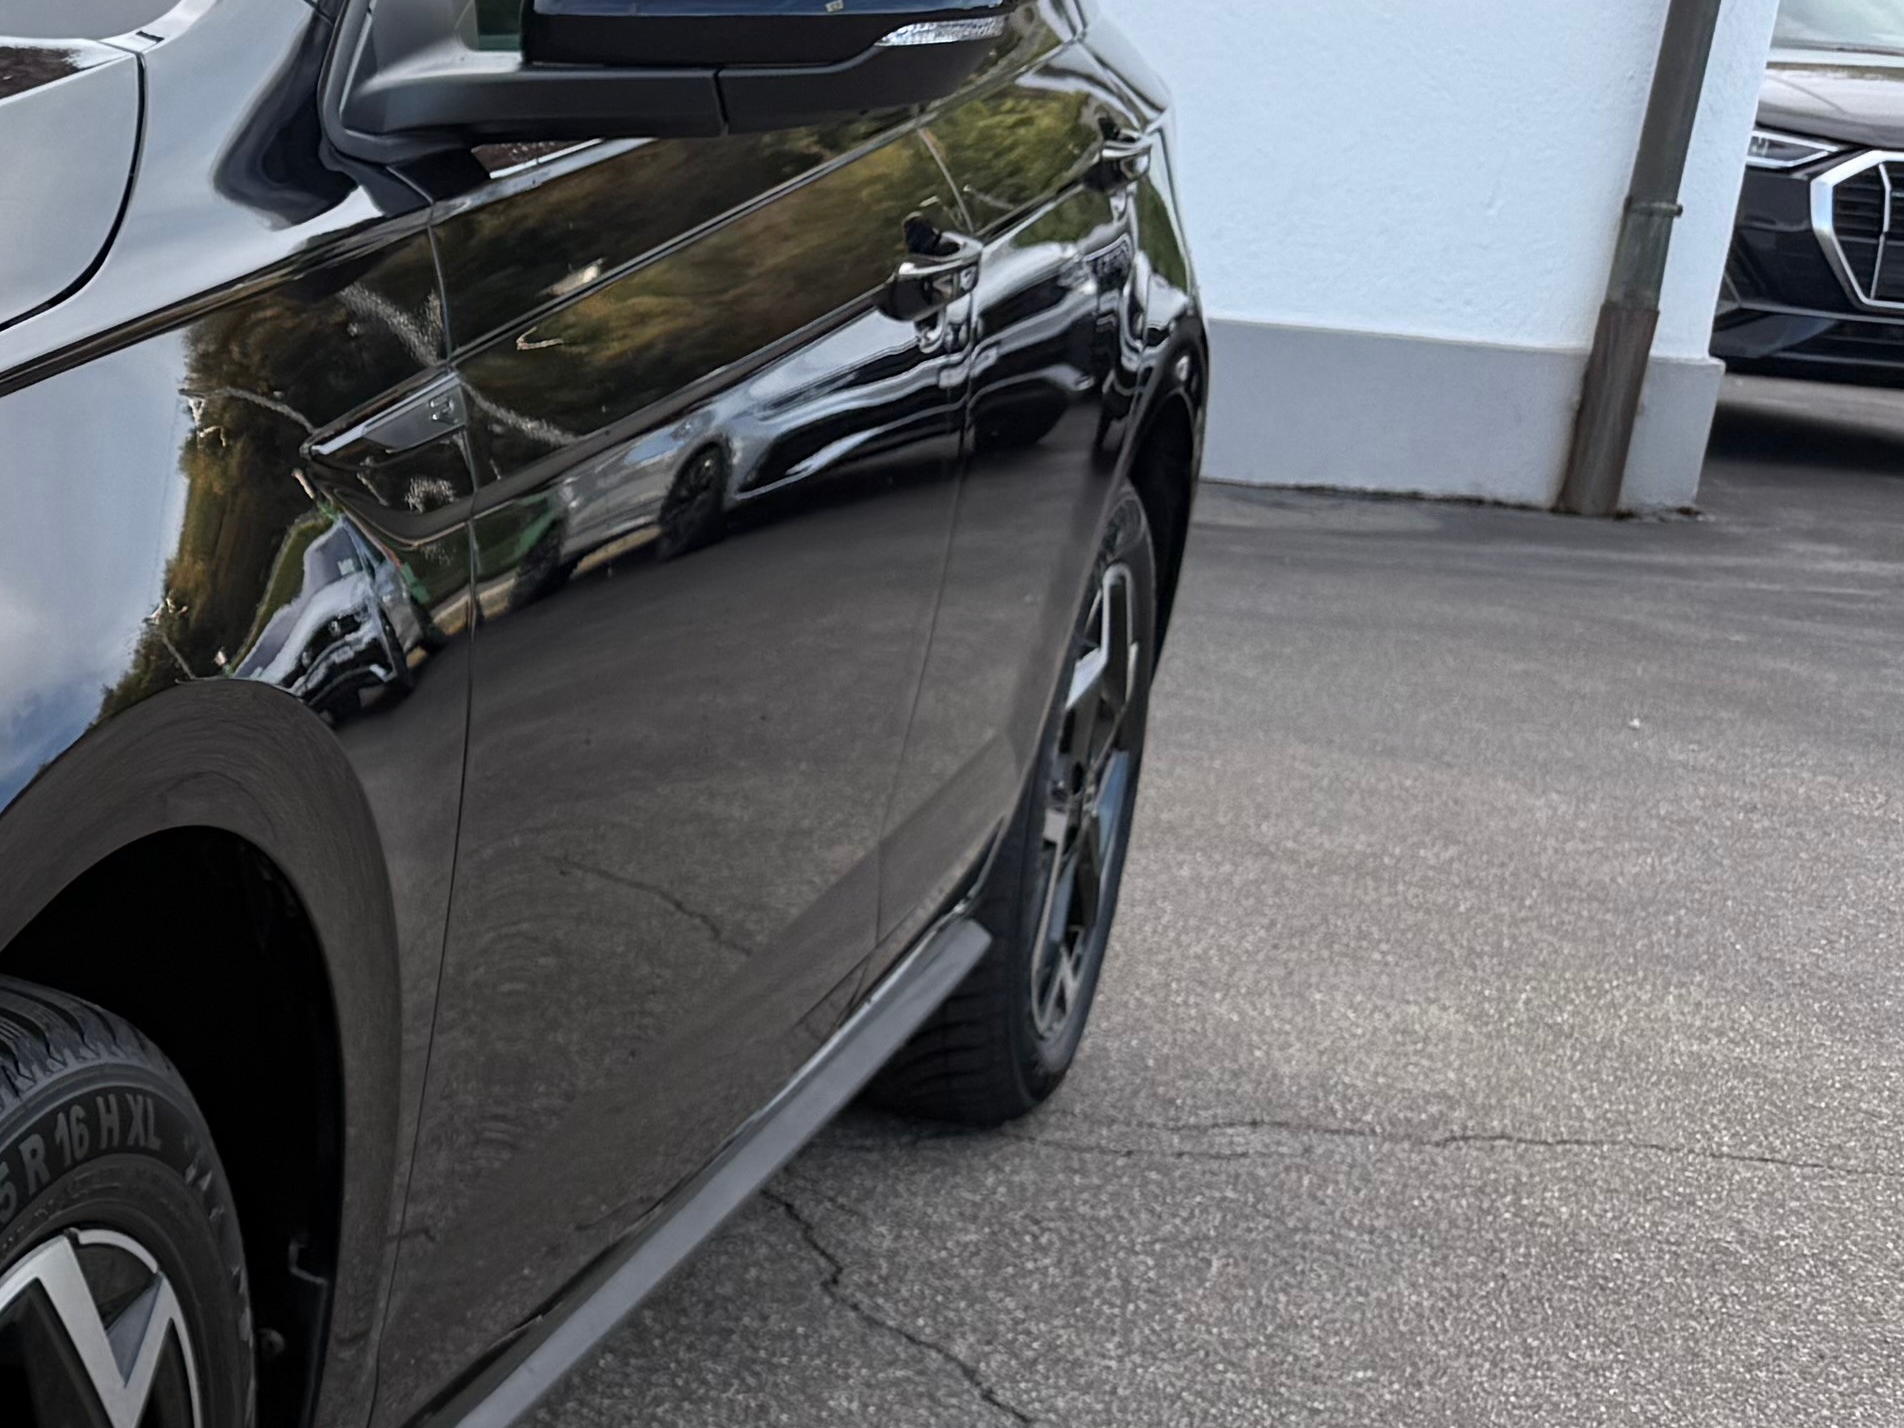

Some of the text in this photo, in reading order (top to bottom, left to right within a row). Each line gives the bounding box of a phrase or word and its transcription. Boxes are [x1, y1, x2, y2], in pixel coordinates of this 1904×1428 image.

[18, 1134, 50, 1197] R
[54, 1104, 90, 1166] 16
[97, 1093, 121, 1149] H
[124, 1093, 163, 1150] XL
